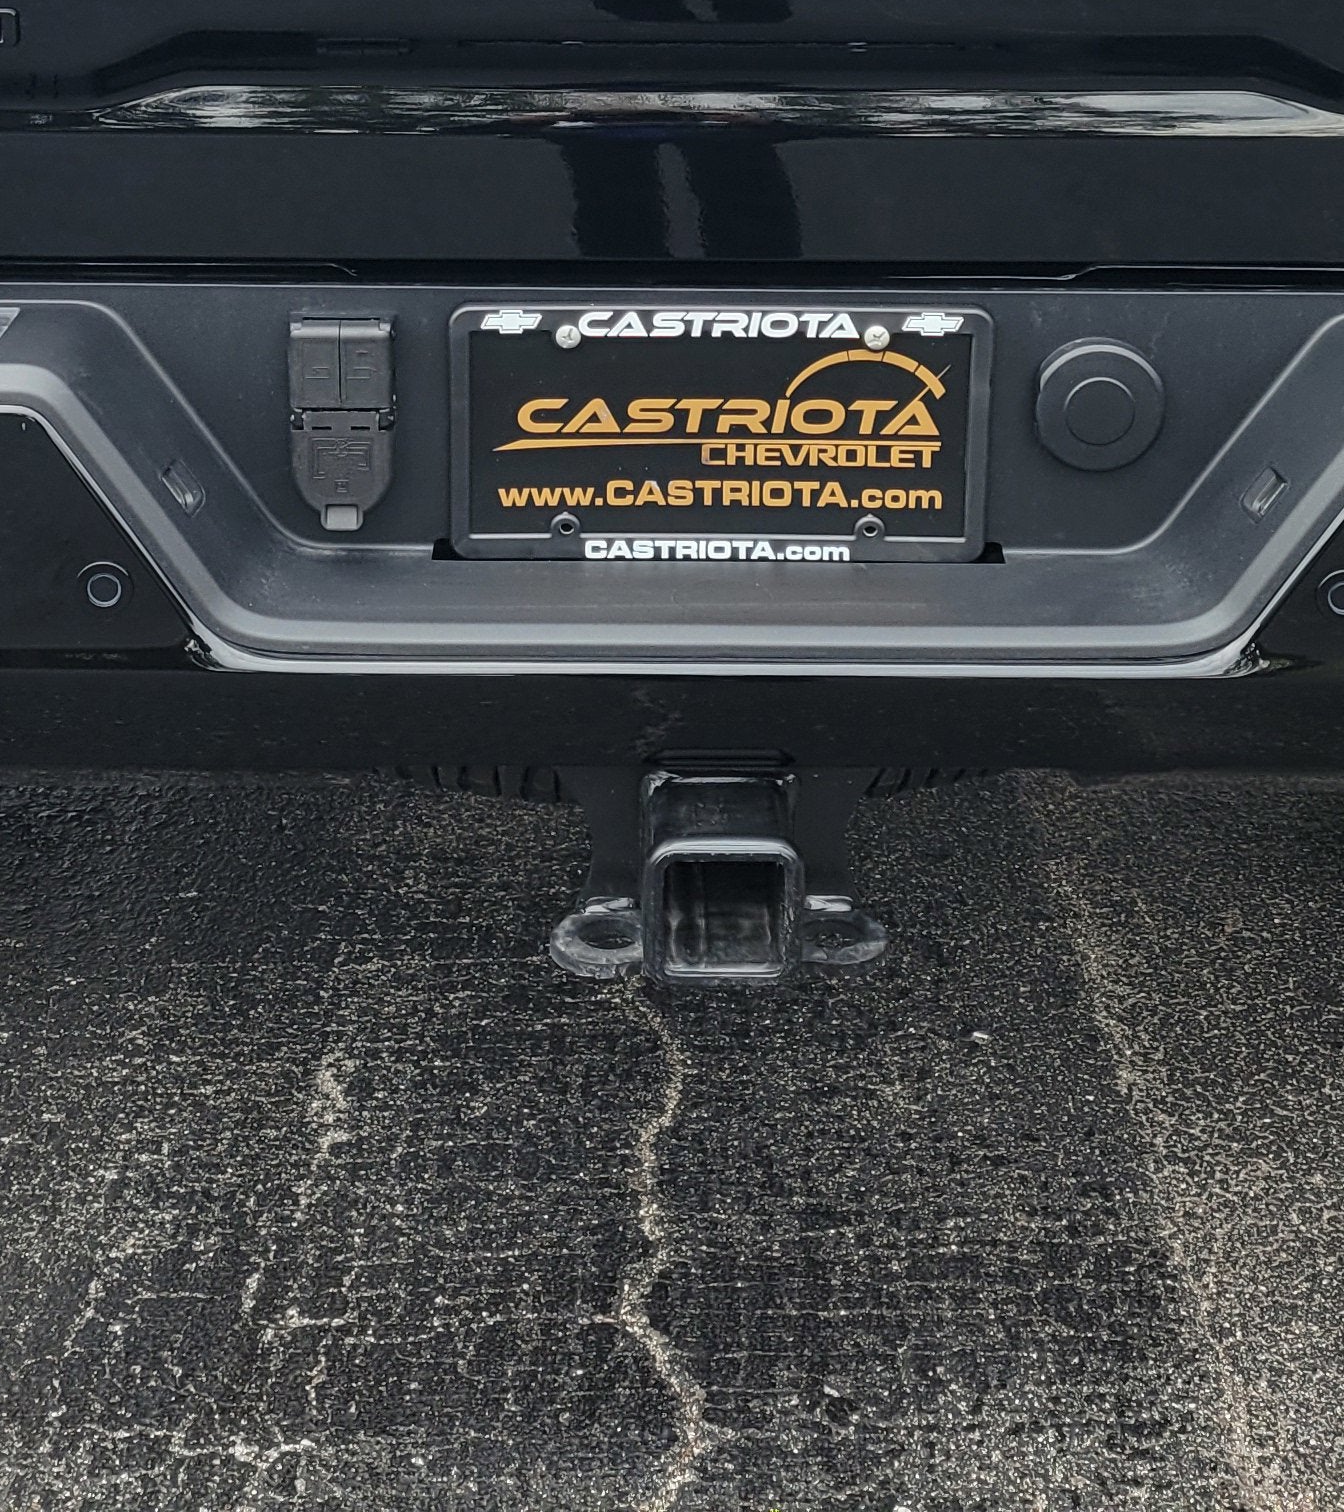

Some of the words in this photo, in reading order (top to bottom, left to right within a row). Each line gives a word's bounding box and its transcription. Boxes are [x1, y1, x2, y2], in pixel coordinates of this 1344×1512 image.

[577, 311, 861, 339] CASTRIOTA
[517, 397, 941, 436] CASTRIOTA
[701, 443, 942, 469] CHEVROLET
[498, 479, 943, 510] www.CASTRIOTA.com
[584, 539, 851, 562] CASTRIOTA.com
